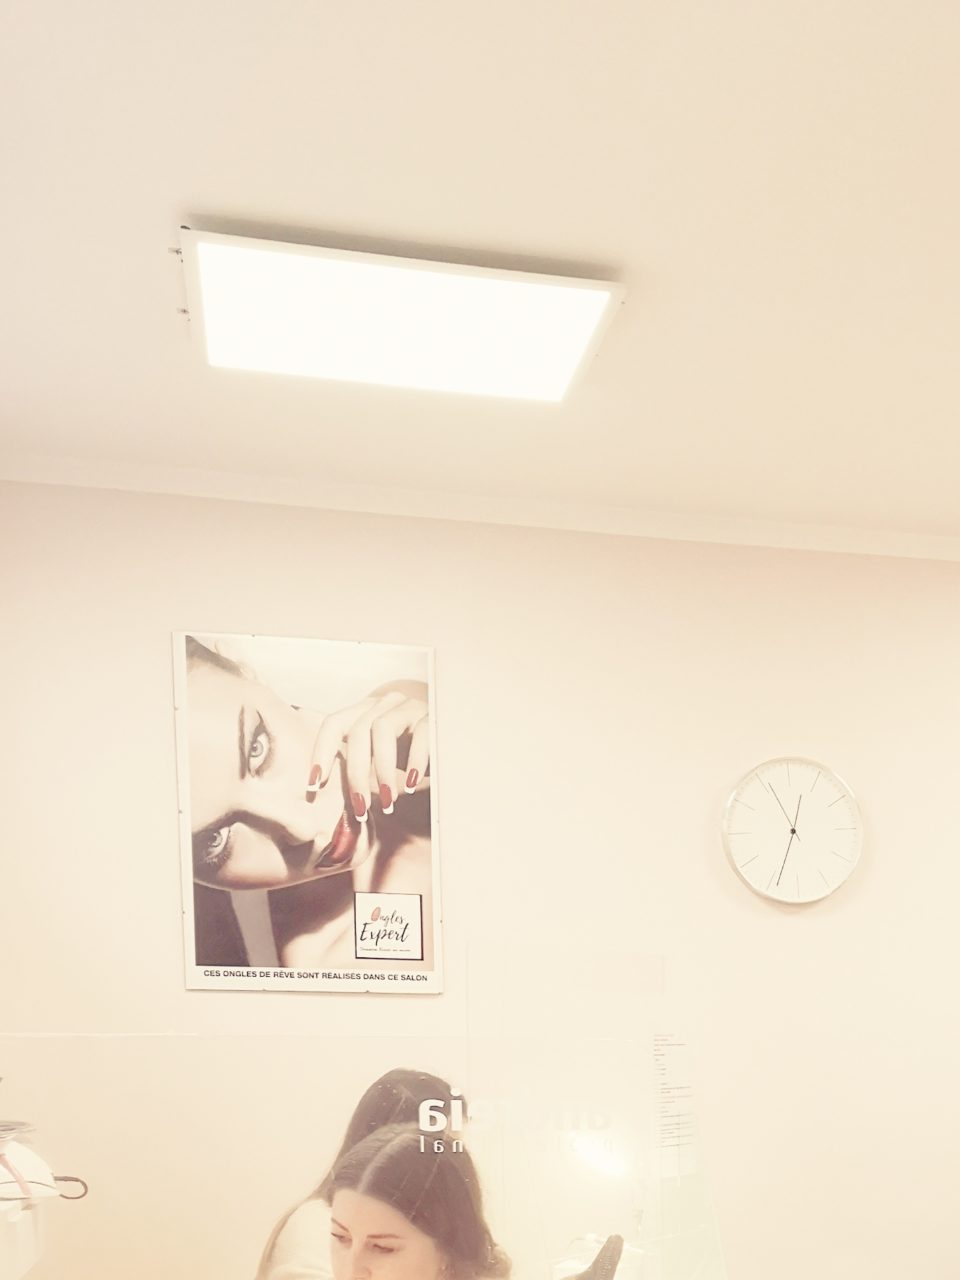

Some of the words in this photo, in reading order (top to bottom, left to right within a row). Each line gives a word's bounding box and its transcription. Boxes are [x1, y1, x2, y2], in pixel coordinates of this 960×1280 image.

[359, 922, 410, 947] Expert
[203, 969, 221, 977] CES
[222, 970, 258, 978] ONGLES
[363, 973, 386, 981] DANS
